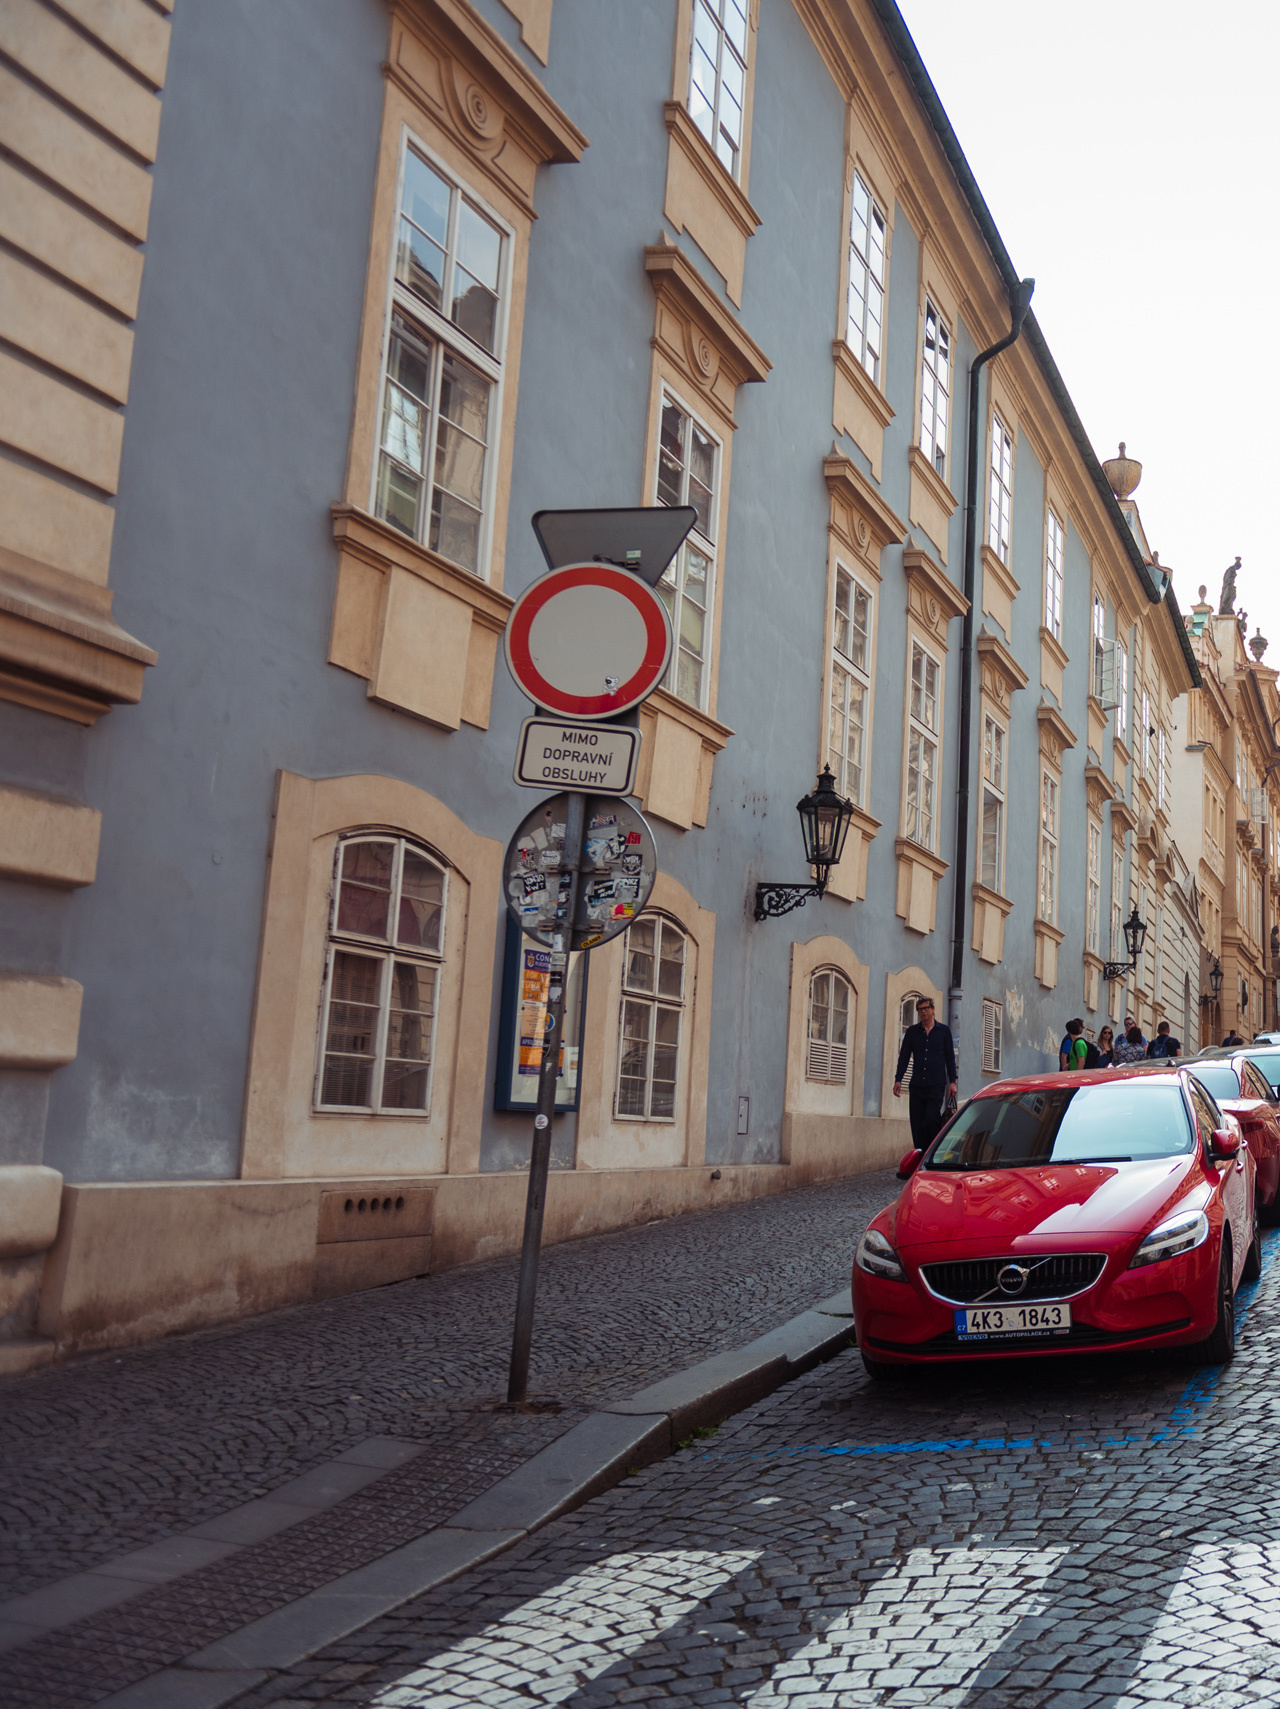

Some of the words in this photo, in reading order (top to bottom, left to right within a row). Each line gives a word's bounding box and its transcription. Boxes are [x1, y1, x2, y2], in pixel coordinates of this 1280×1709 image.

[561, 731, 598, 746] MIMO
[543, 747, 613, 766] DOPRAVNÍ
[542, 766, 607, 784] OBSLUHY
[971, 1310, 1004, 1331] 4K3
[1018, 1307, 1062, 1328] 1843
[990, 1331, 1050, 1339] www.AUTOPALACE.cz
